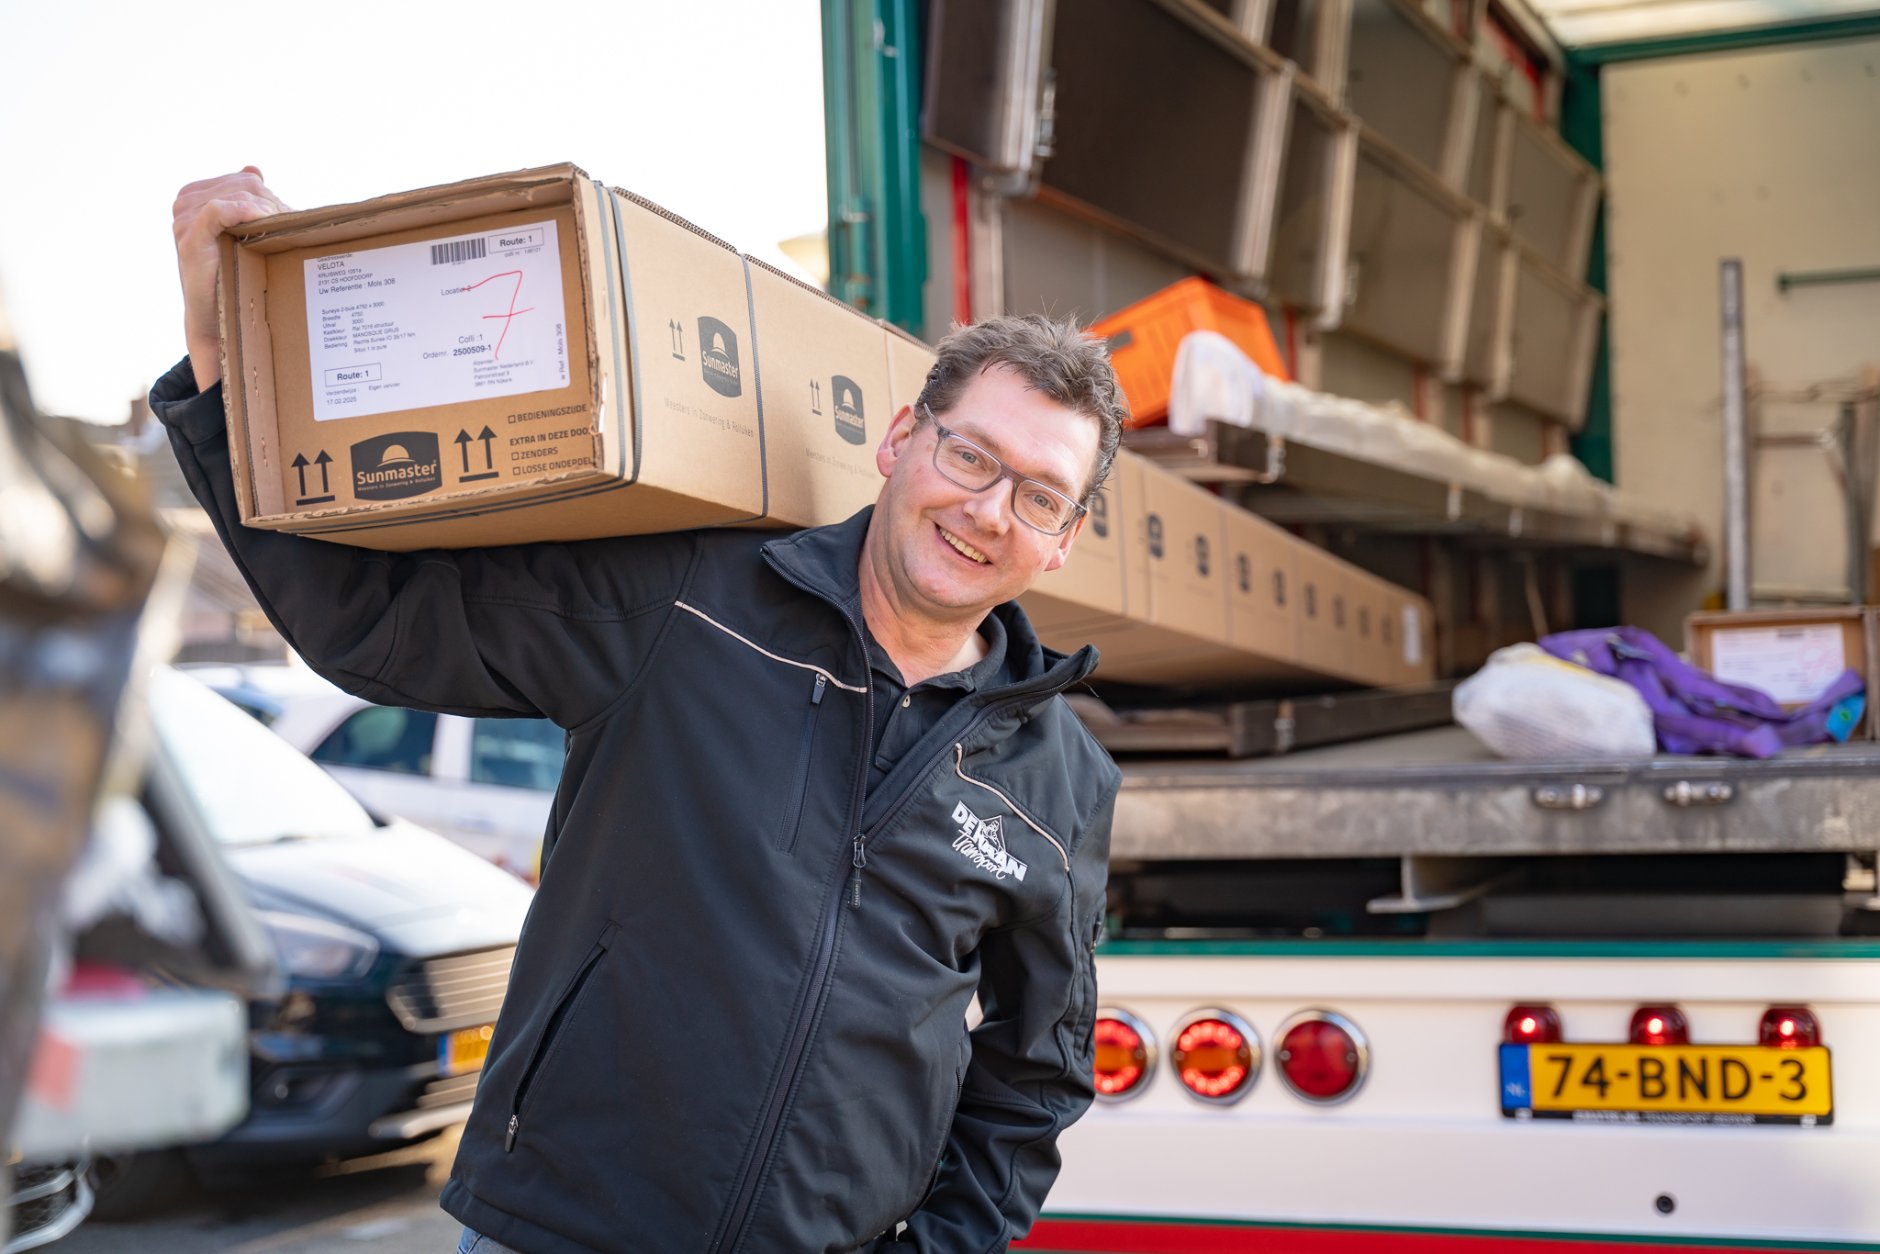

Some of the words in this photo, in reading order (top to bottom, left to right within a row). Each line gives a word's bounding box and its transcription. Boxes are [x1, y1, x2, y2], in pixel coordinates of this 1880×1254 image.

[499, 236, 526, 248] Route:
[528, 235, 533, 243] 1
[317, 260, 345, 271] VELOTA
[318, 286, 329, 295] Uw
[330, 282, 363, 293] Referentie
[458, 334, 475, 344] Colli
[452, 344, 492, 357] 2500509-1
[702, 350, 739, 379] Sunmaster
[336, 372, 363, 381] Route:
[364, 370, 370, 378] 1
[517, 403, 587, 422] BEDIENINGSZIJDE
[834, 404, 864, 429] Sunmaster
[510, 435, 536, 446] EXTRA
[537, 434, 546, 442] IN
[548, 430, 569, 441] DEZE
[570, 427, 590, 438] DOO
[520, 446, 559, 460] ZENDERS
[356, 463, 437, 485] Sunmaster
[522, 462, 548, 474] LOSSE
[952, 800, 979, 837] DE
[1546, 1054, 1808, 1103] 74-BND-3
